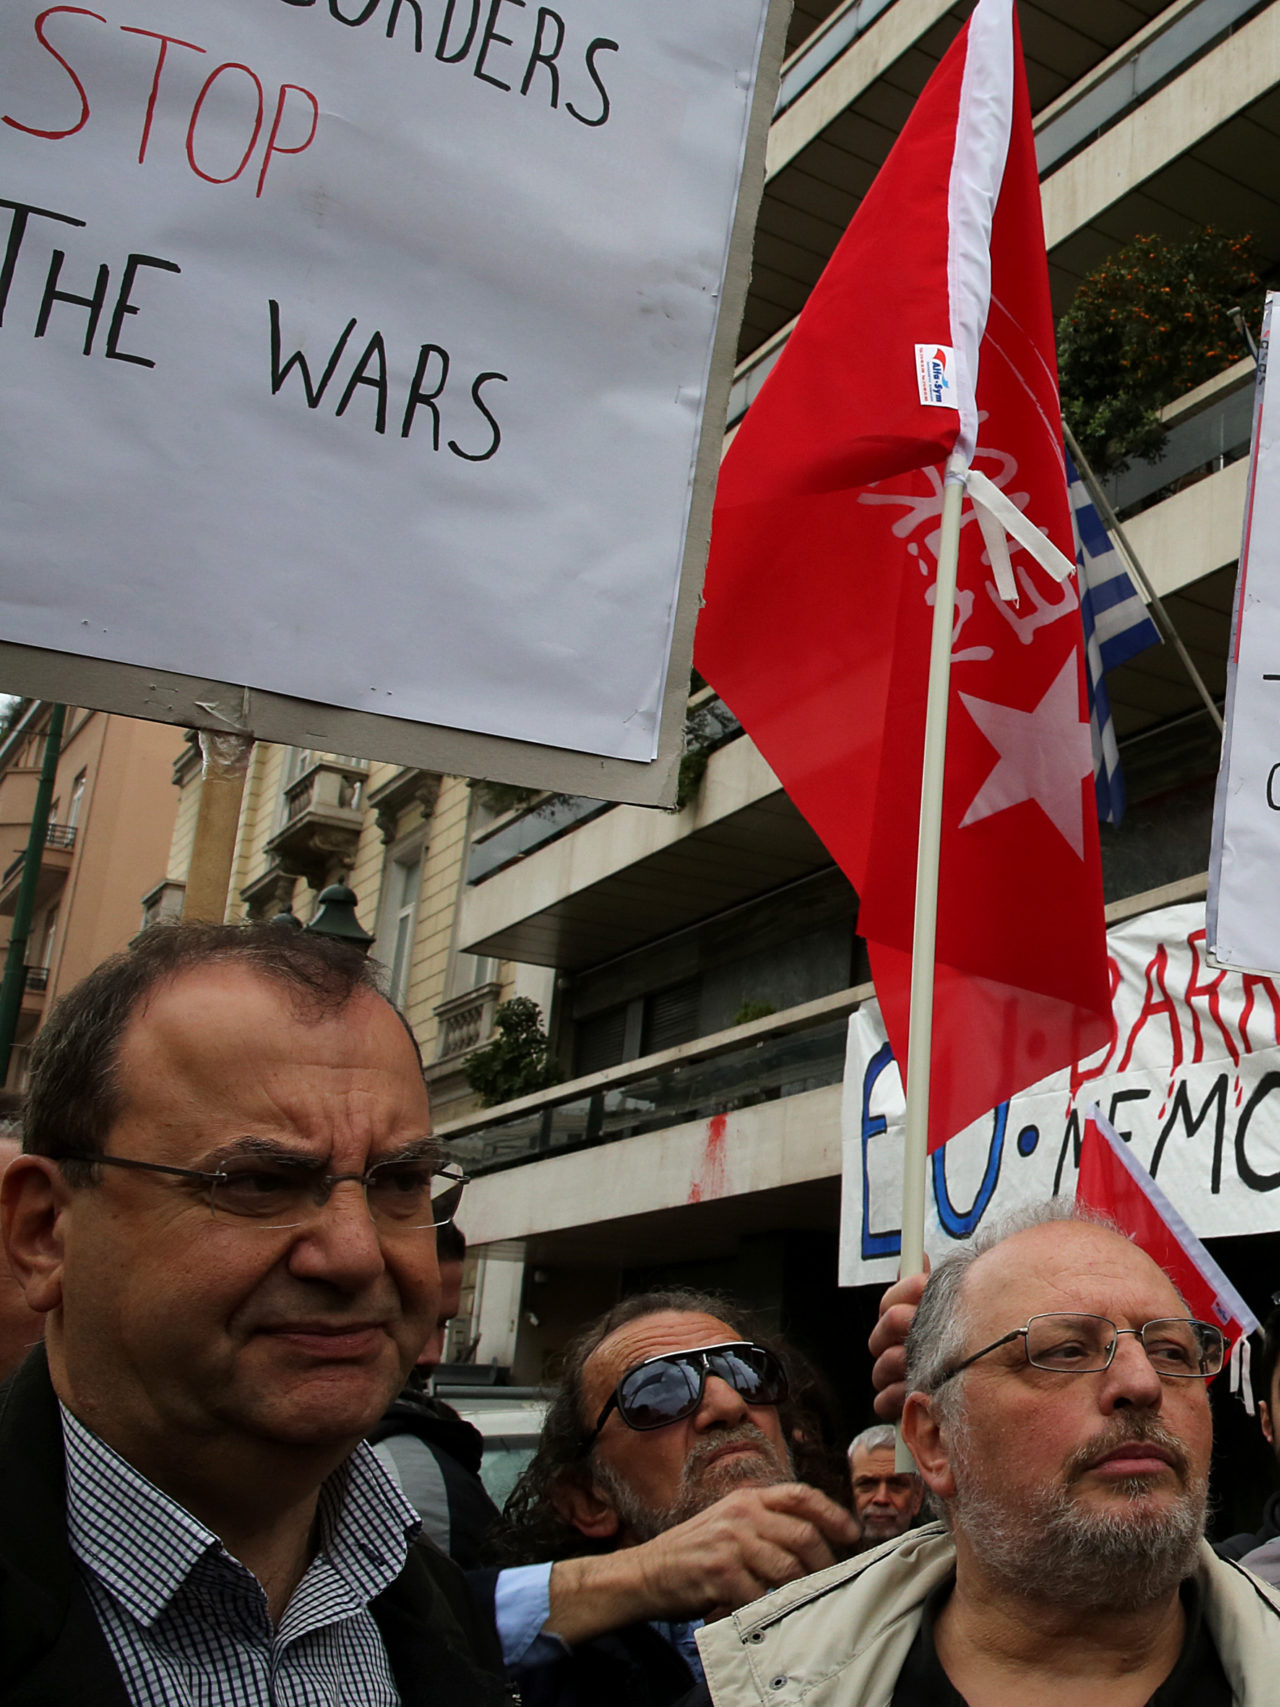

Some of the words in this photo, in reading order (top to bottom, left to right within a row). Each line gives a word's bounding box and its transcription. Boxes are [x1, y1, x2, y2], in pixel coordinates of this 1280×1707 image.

[3, 6, 319, 198] STOP
[0, 199, 181, 368] THE
[269, 299, 508, 461] WARS
